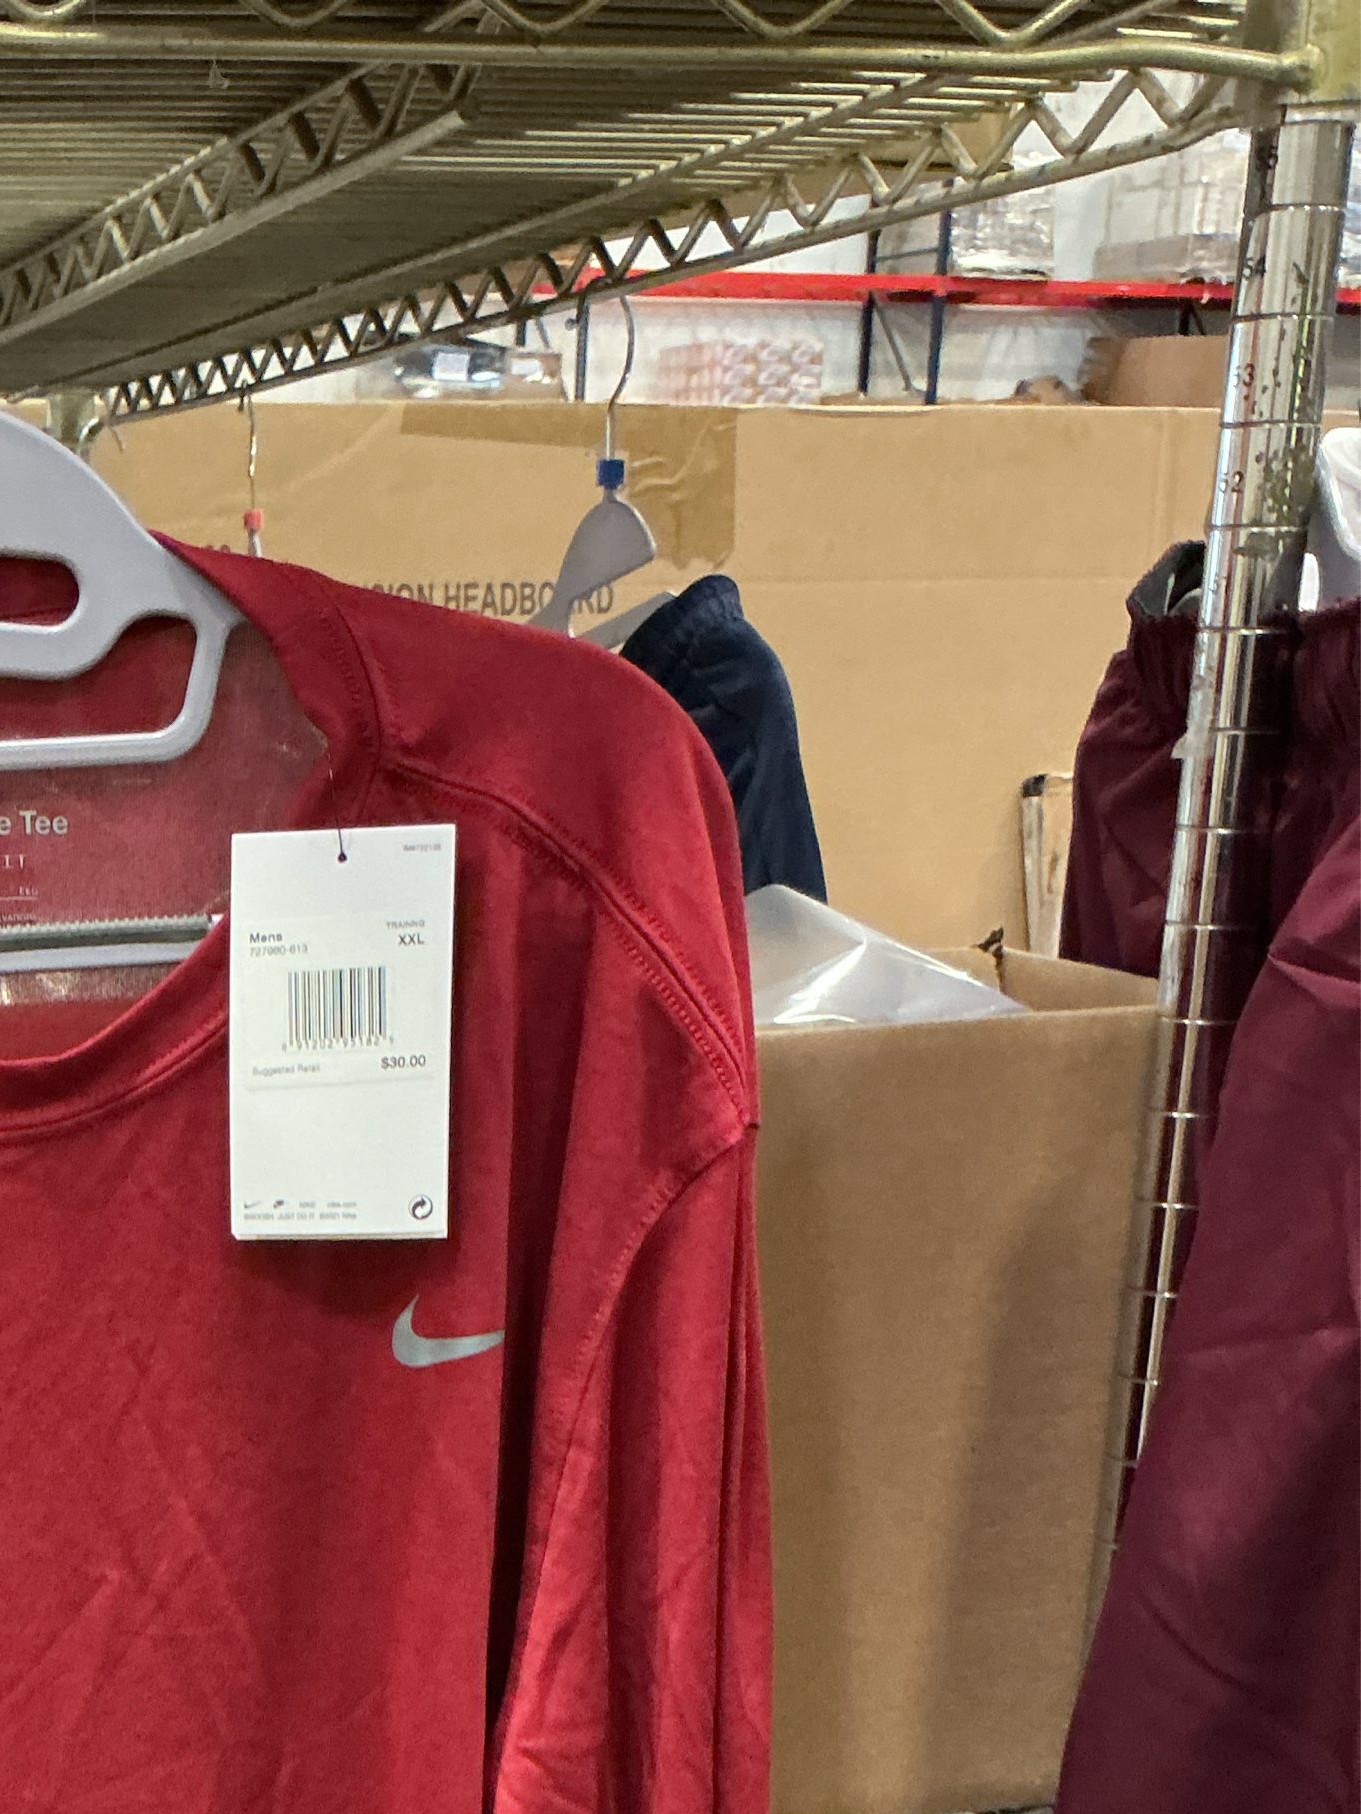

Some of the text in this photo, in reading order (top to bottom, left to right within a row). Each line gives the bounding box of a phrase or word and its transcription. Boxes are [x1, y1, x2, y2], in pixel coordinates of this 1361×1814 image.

[443, 580, 615, 617] HEADBORD
[19, 809, 69, 835] Tee
[249, 931, 283, 944] Mens
[398, 932, 425, 946] XXL
[380, 1054, 427, 1070] $30.00
